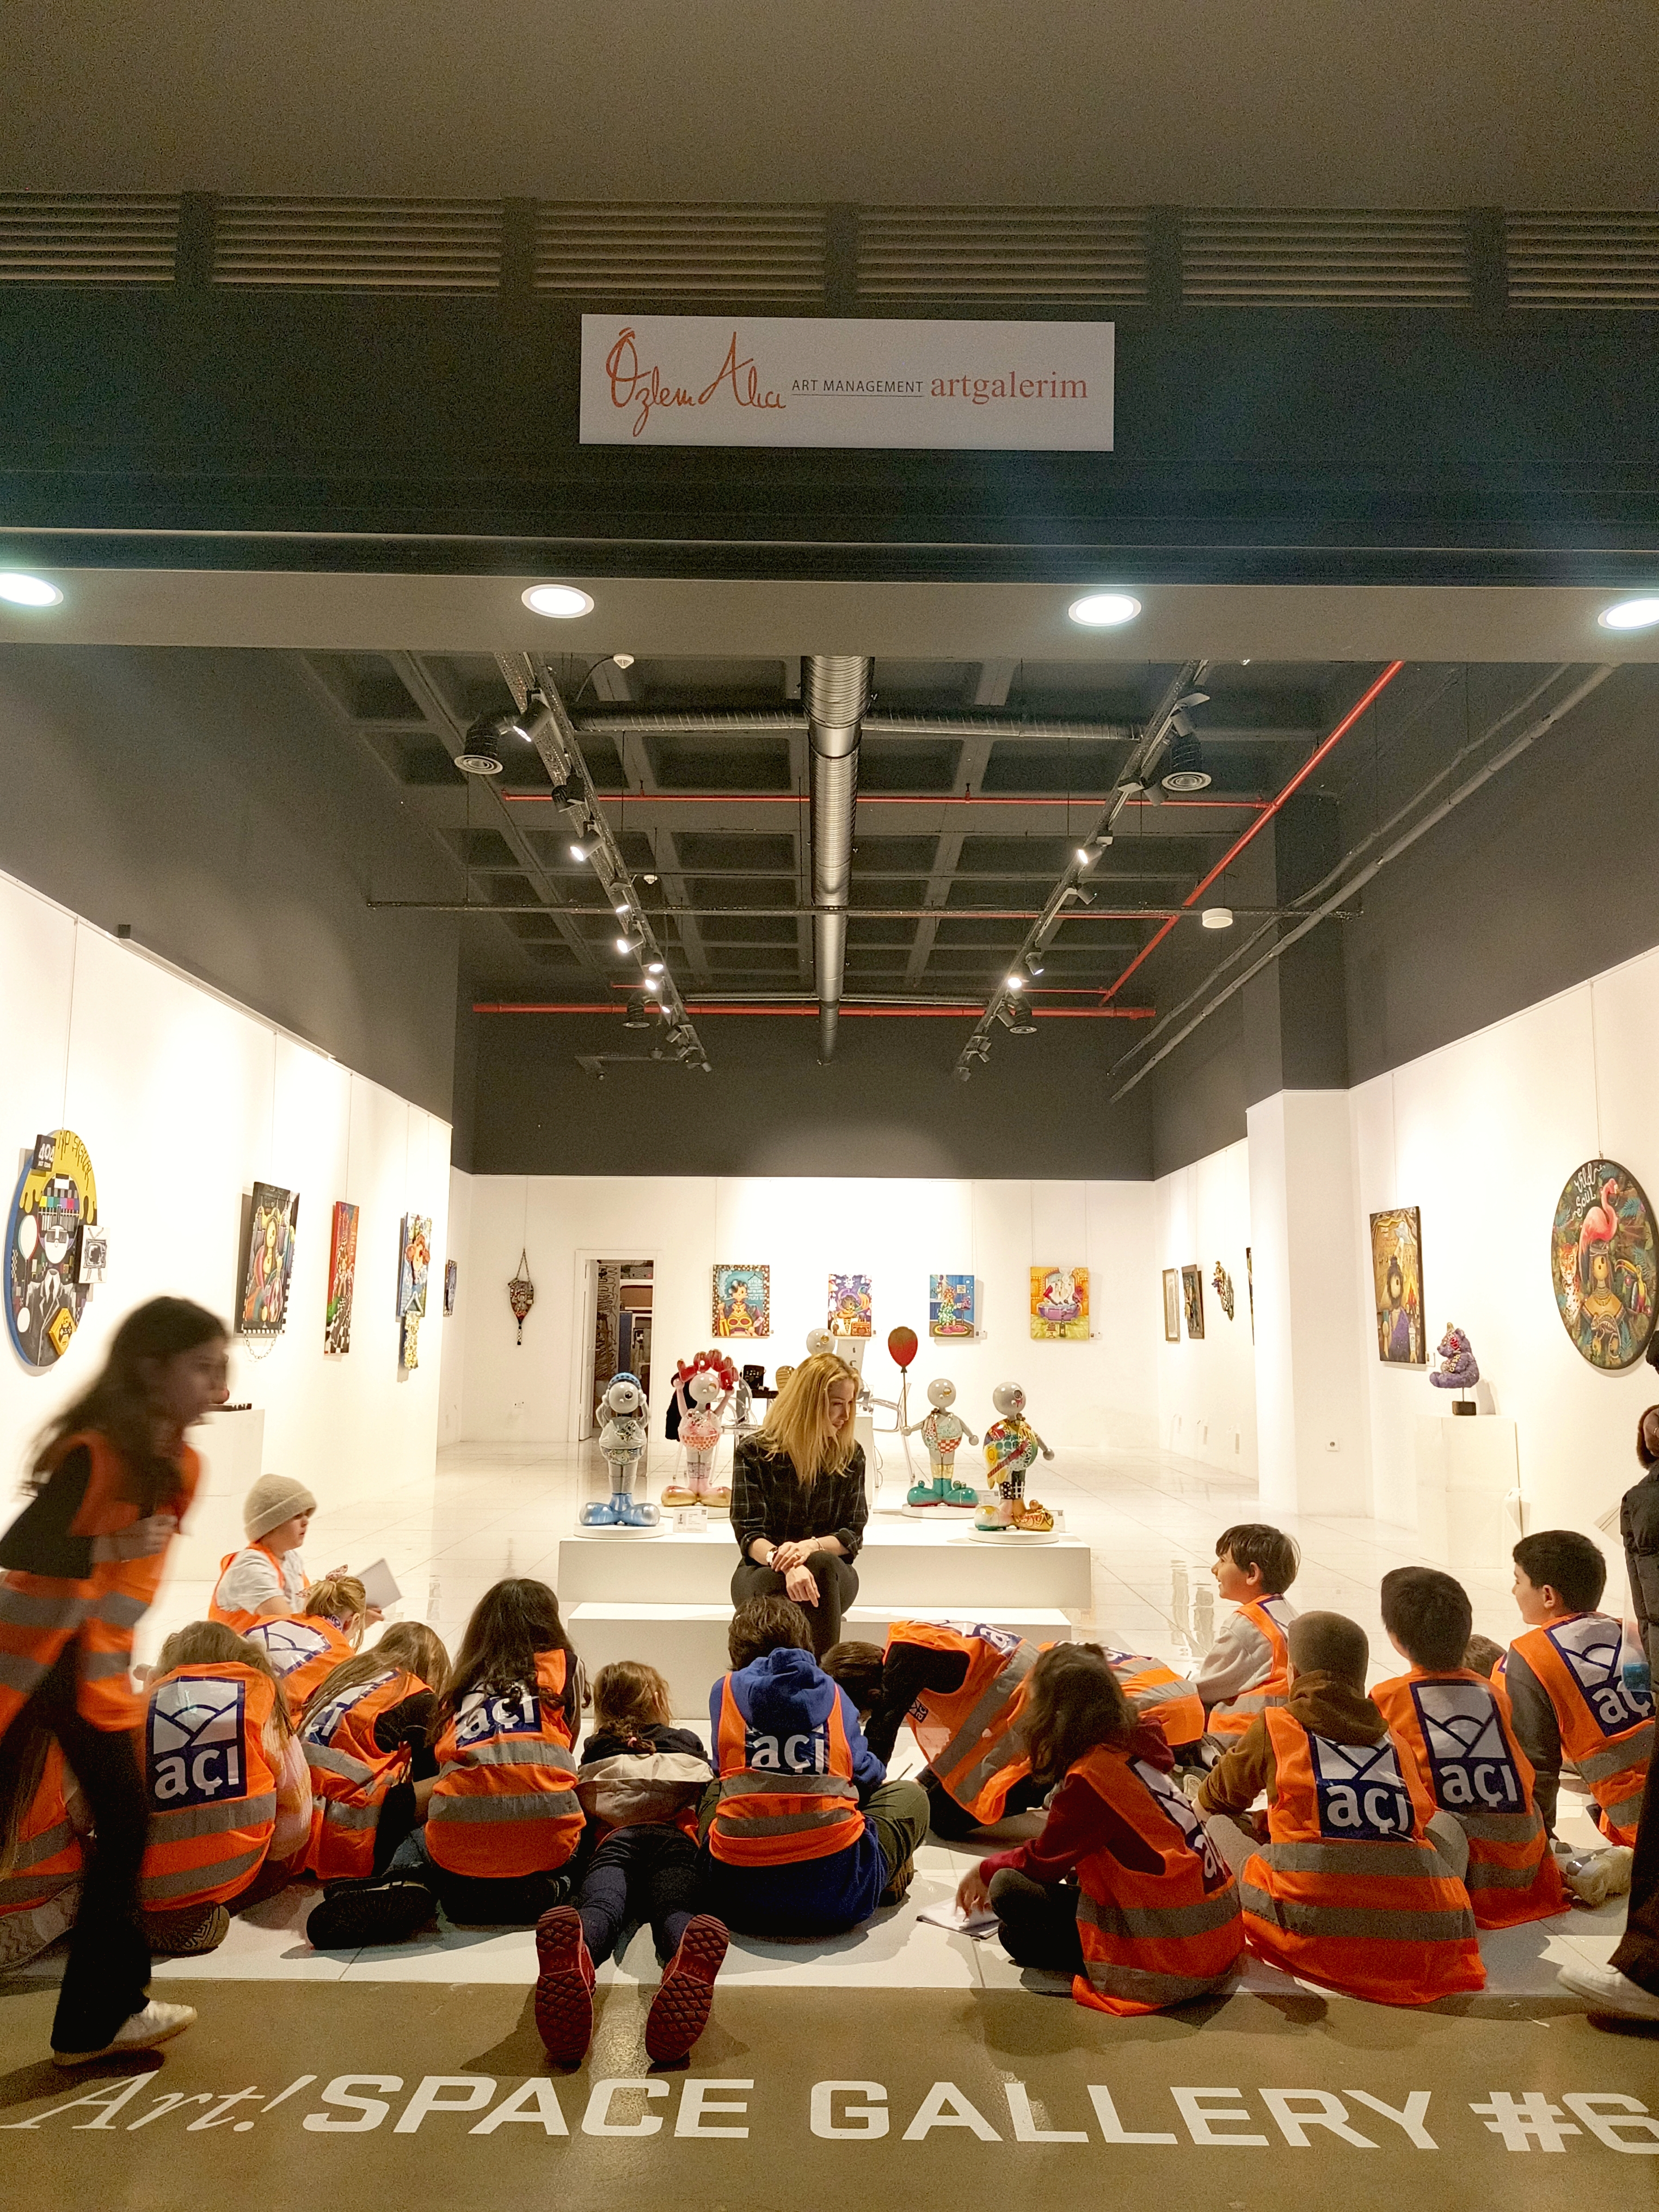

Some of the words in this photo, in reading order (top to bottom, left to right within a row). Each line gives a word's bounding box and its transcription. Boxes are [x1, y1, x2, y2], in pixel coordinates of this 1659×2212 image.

[792, 379, 818, 392] ART
[824, 379, 924, 393] MANAGEMENT
[931, 371, 1088, 405] artgalerim
[39, 1144, 56, 1162] 404
[1592, 1680, 1655, 1724] aç
[155, 1745, 239, 1799] açı
[1439, 1764, 1518, 1808] açı
[1326, 1785, 1409, 1834] açı
[302, 2074, 754, 2139] SPACE
[810, 2080, 1440, 2149] GALLERY
[1468, 2091, 1659, 2154] #6
